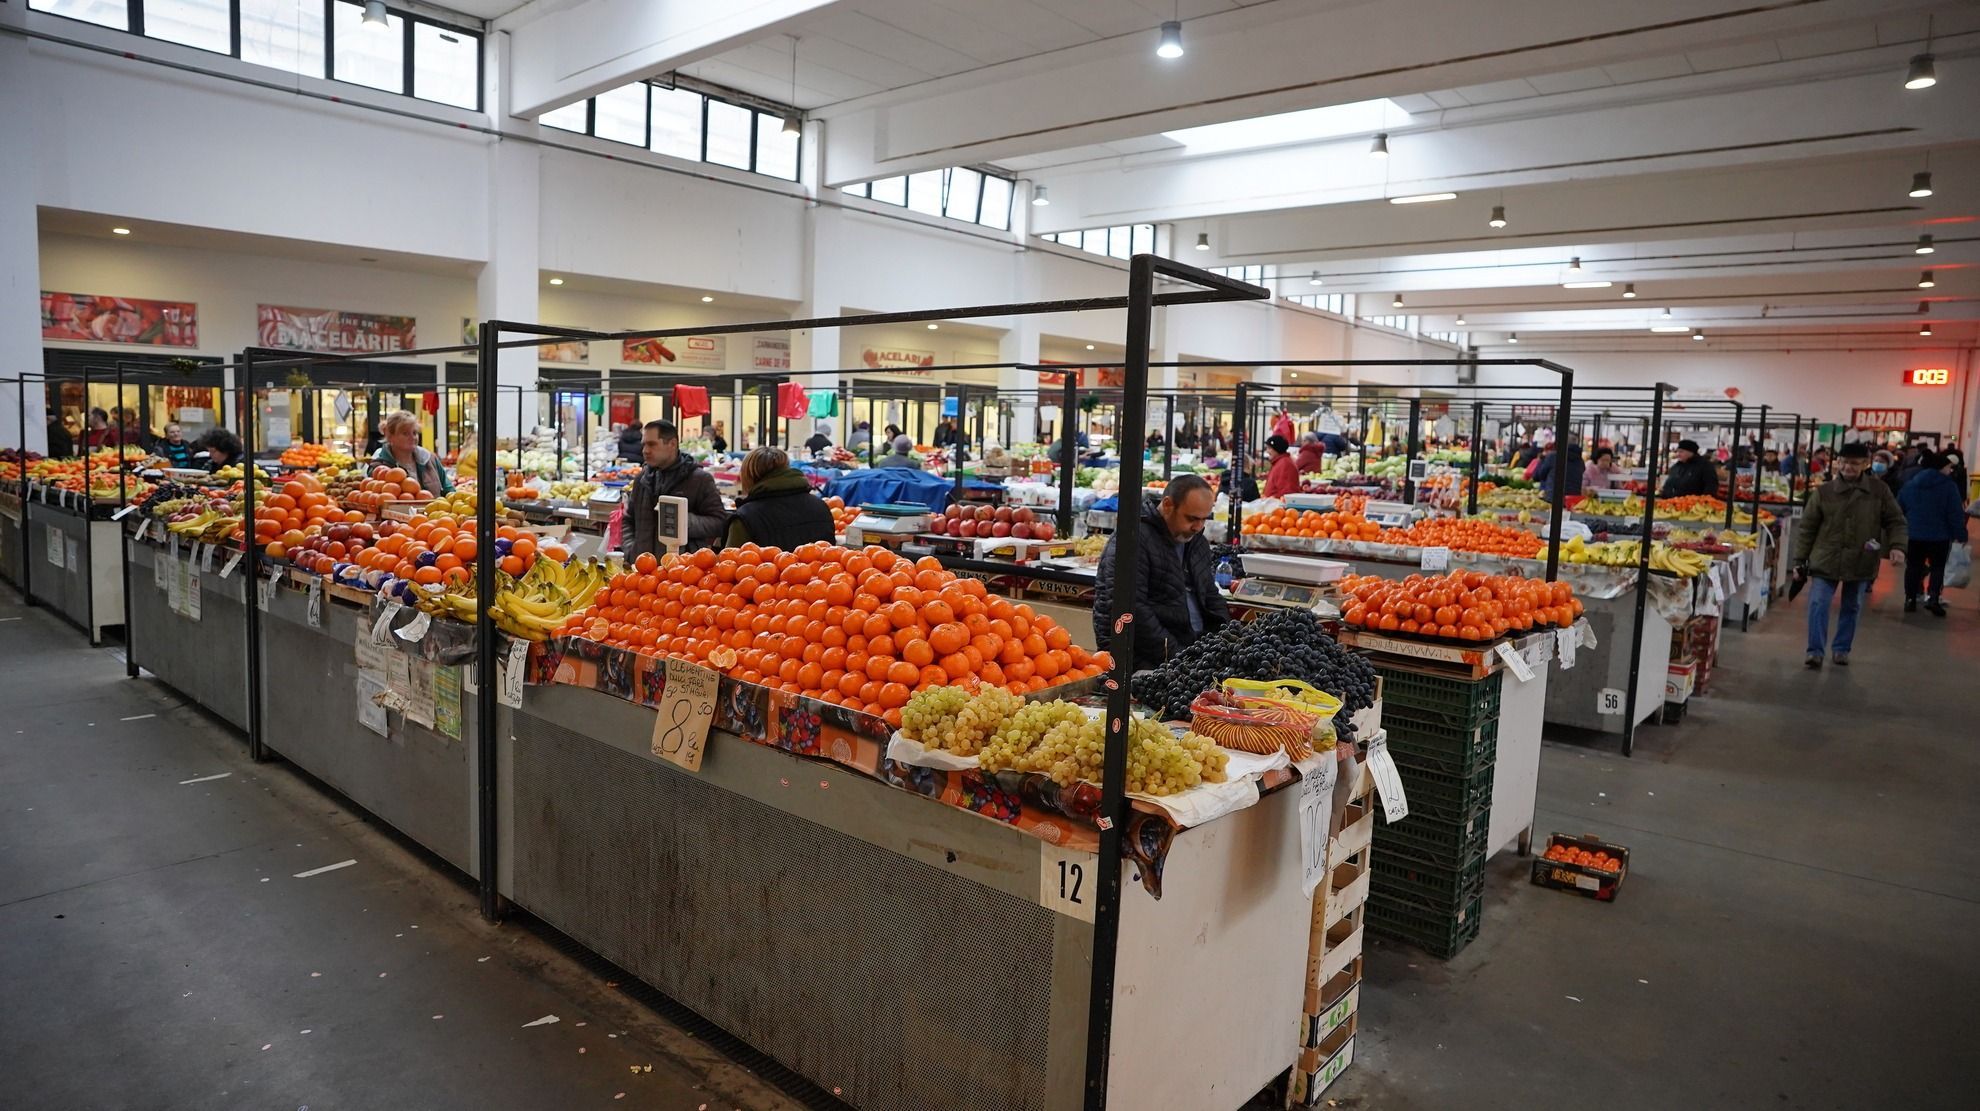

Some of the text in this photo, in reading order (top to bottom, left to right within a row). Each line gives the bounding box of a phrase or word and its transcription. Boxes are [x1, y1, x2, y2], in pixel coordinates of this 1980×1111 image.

[1855, 411, 1907, 428] BAZAR
[1038, 581, 1079, 595] SAMBA
[1605, 694, 1618, 709] 56
[661, 699, 692, 755] 8
[1058, 860, 1083, 905] 12
